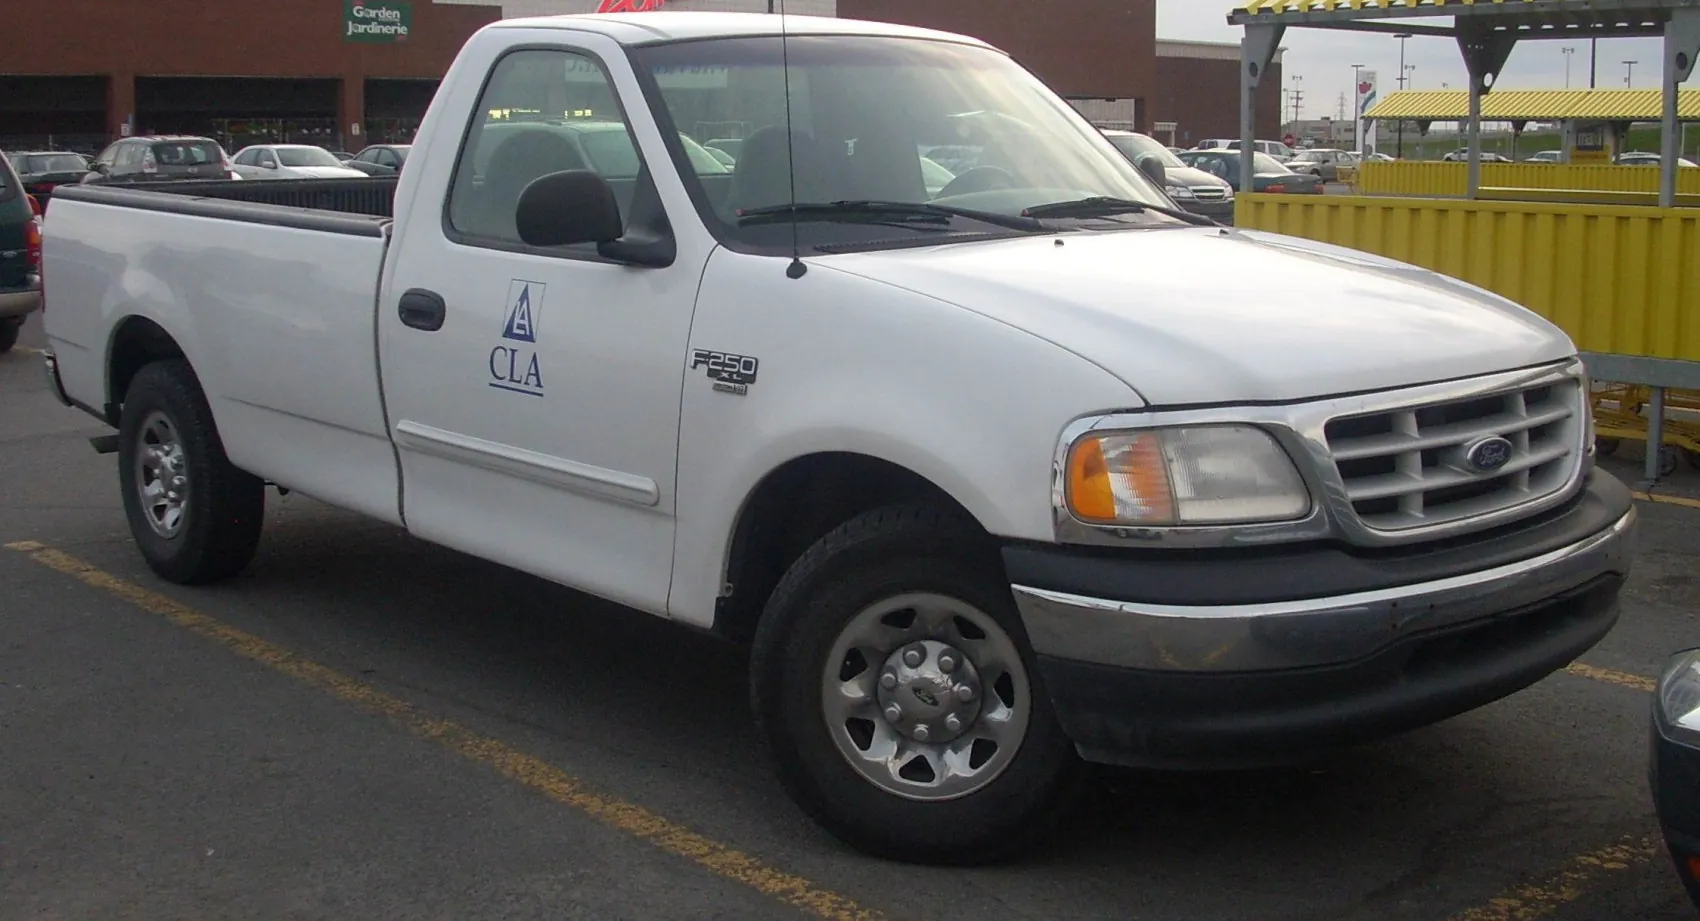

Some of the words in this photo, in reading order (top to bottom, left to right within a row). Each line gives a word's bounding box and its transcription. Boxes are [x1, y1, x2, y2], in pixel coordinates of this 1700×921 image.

[352, 5, 400, 18] Garden
[347, 20, 408, 35] Jardinerie
[489, 345, 544, 389] CLA
[720, 371, 742, 380] XL
